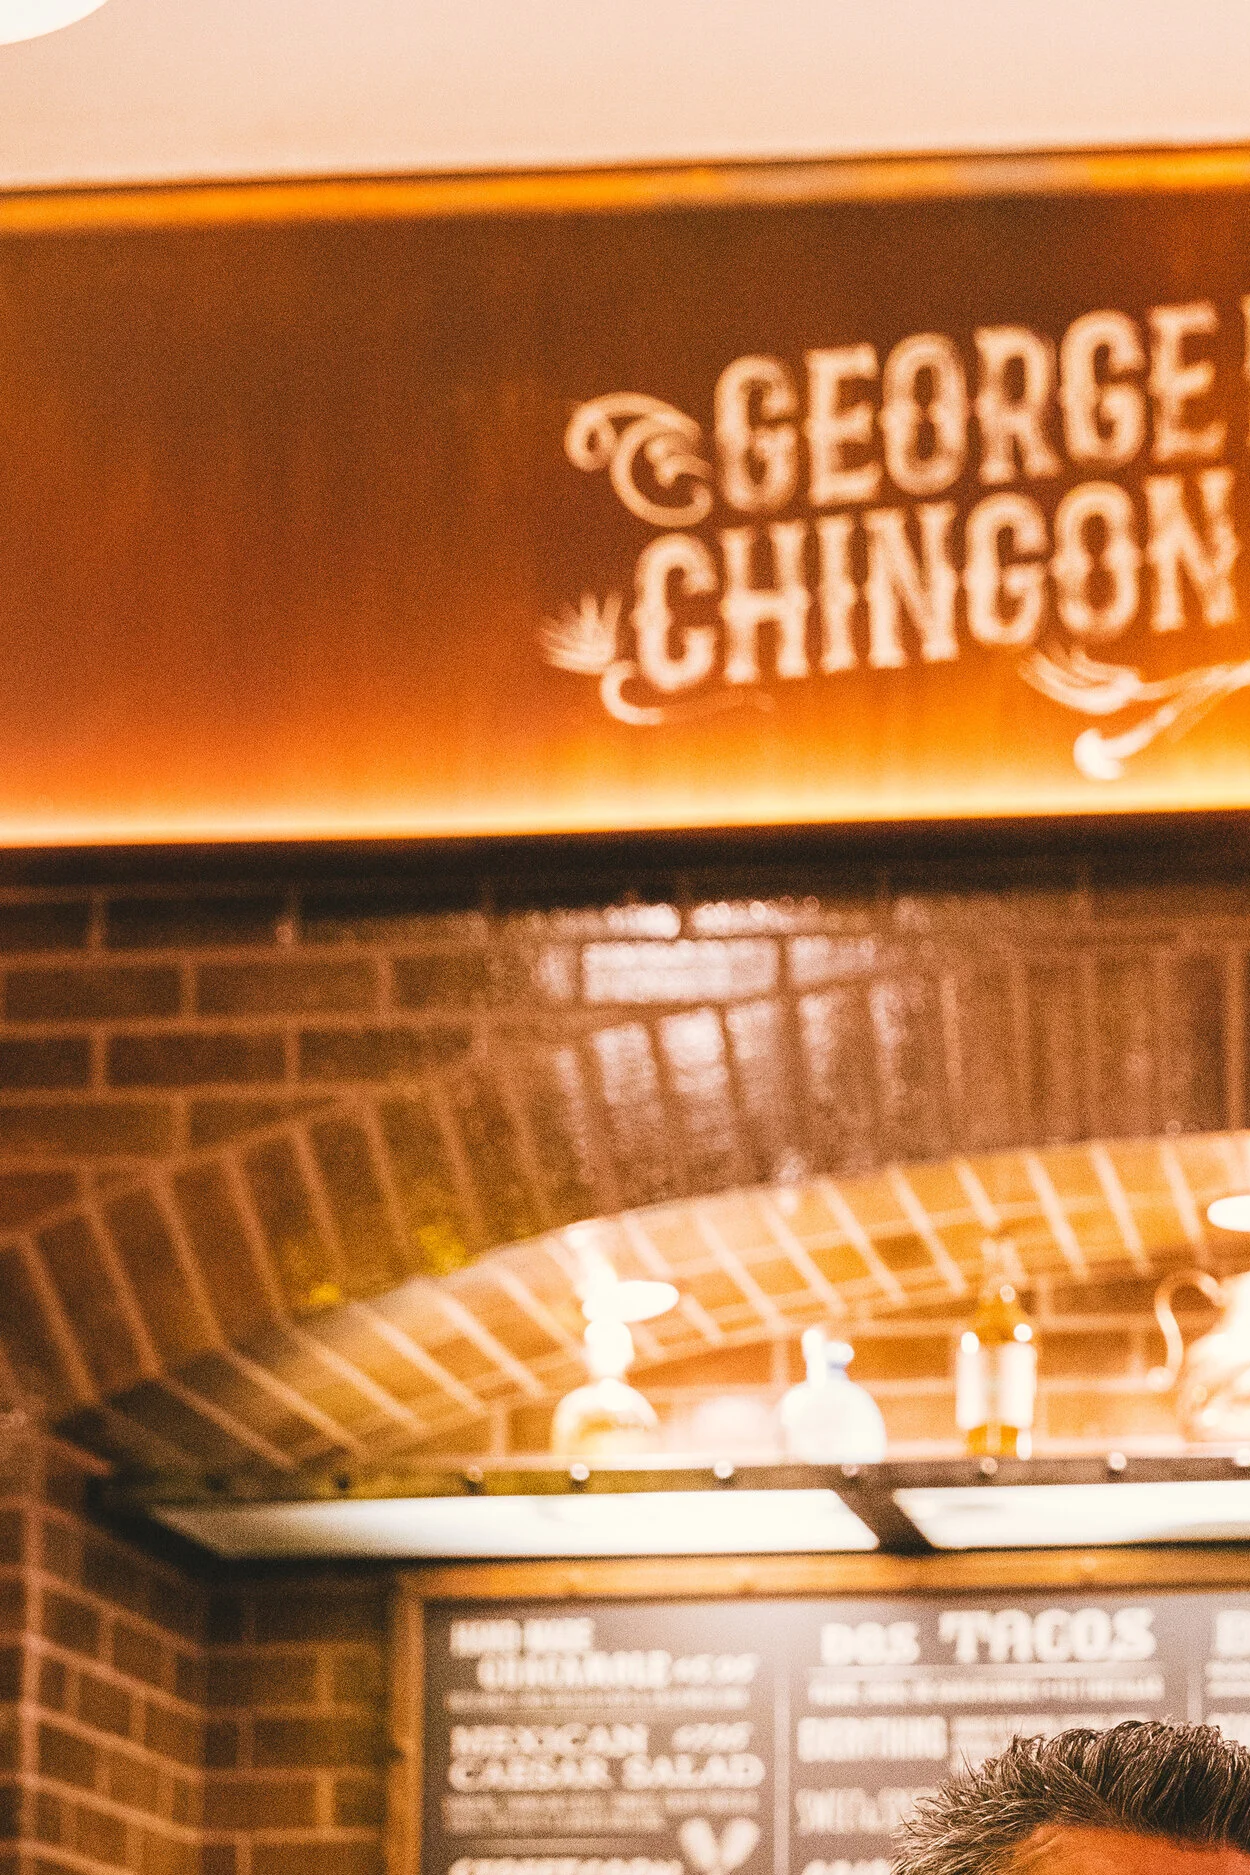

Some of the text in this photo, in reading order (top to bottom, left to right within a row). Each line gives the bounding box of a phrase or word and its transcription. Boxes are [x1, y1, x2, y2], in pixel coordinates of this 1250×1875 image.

[713, 300, 1229, 513] GEORGE
[631, 466, 1240, 694] CHINGON
[820, 1606, 1158, 1666] DOS TACOS
